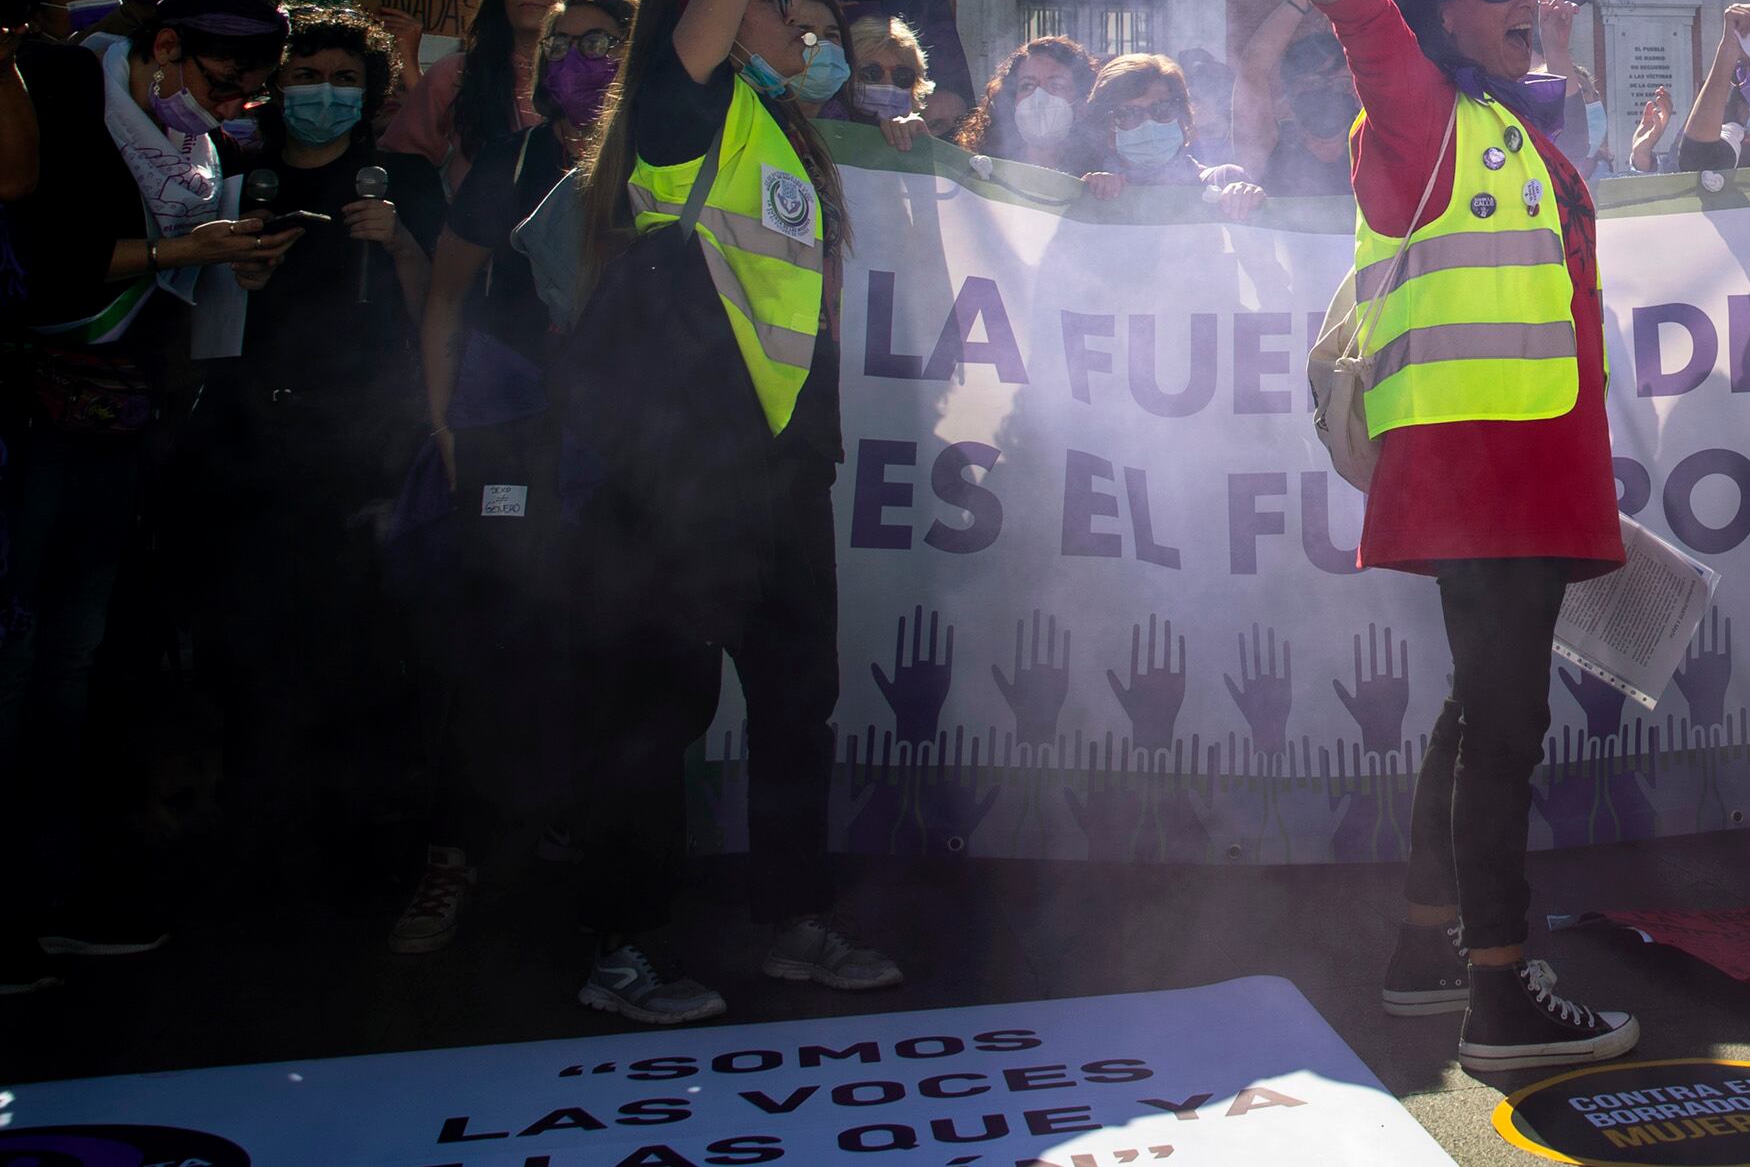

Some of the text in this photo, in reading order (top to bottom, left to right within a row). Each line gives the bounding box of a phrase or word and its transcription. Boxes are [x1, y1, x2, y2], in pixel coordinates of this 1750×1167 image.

[863, 270, 1030, 384] LA
[851, 438, 1003, 554] ES
[1060, 448, 1182, 571] EL
[436, 1058, 1156, 1145] LAS VOCES
[836, 1105, 1104, 1152] QUE
[1137, 1086, 1307, 1121] YA
[1568, 1083, 1721, 1112] CONTRA
